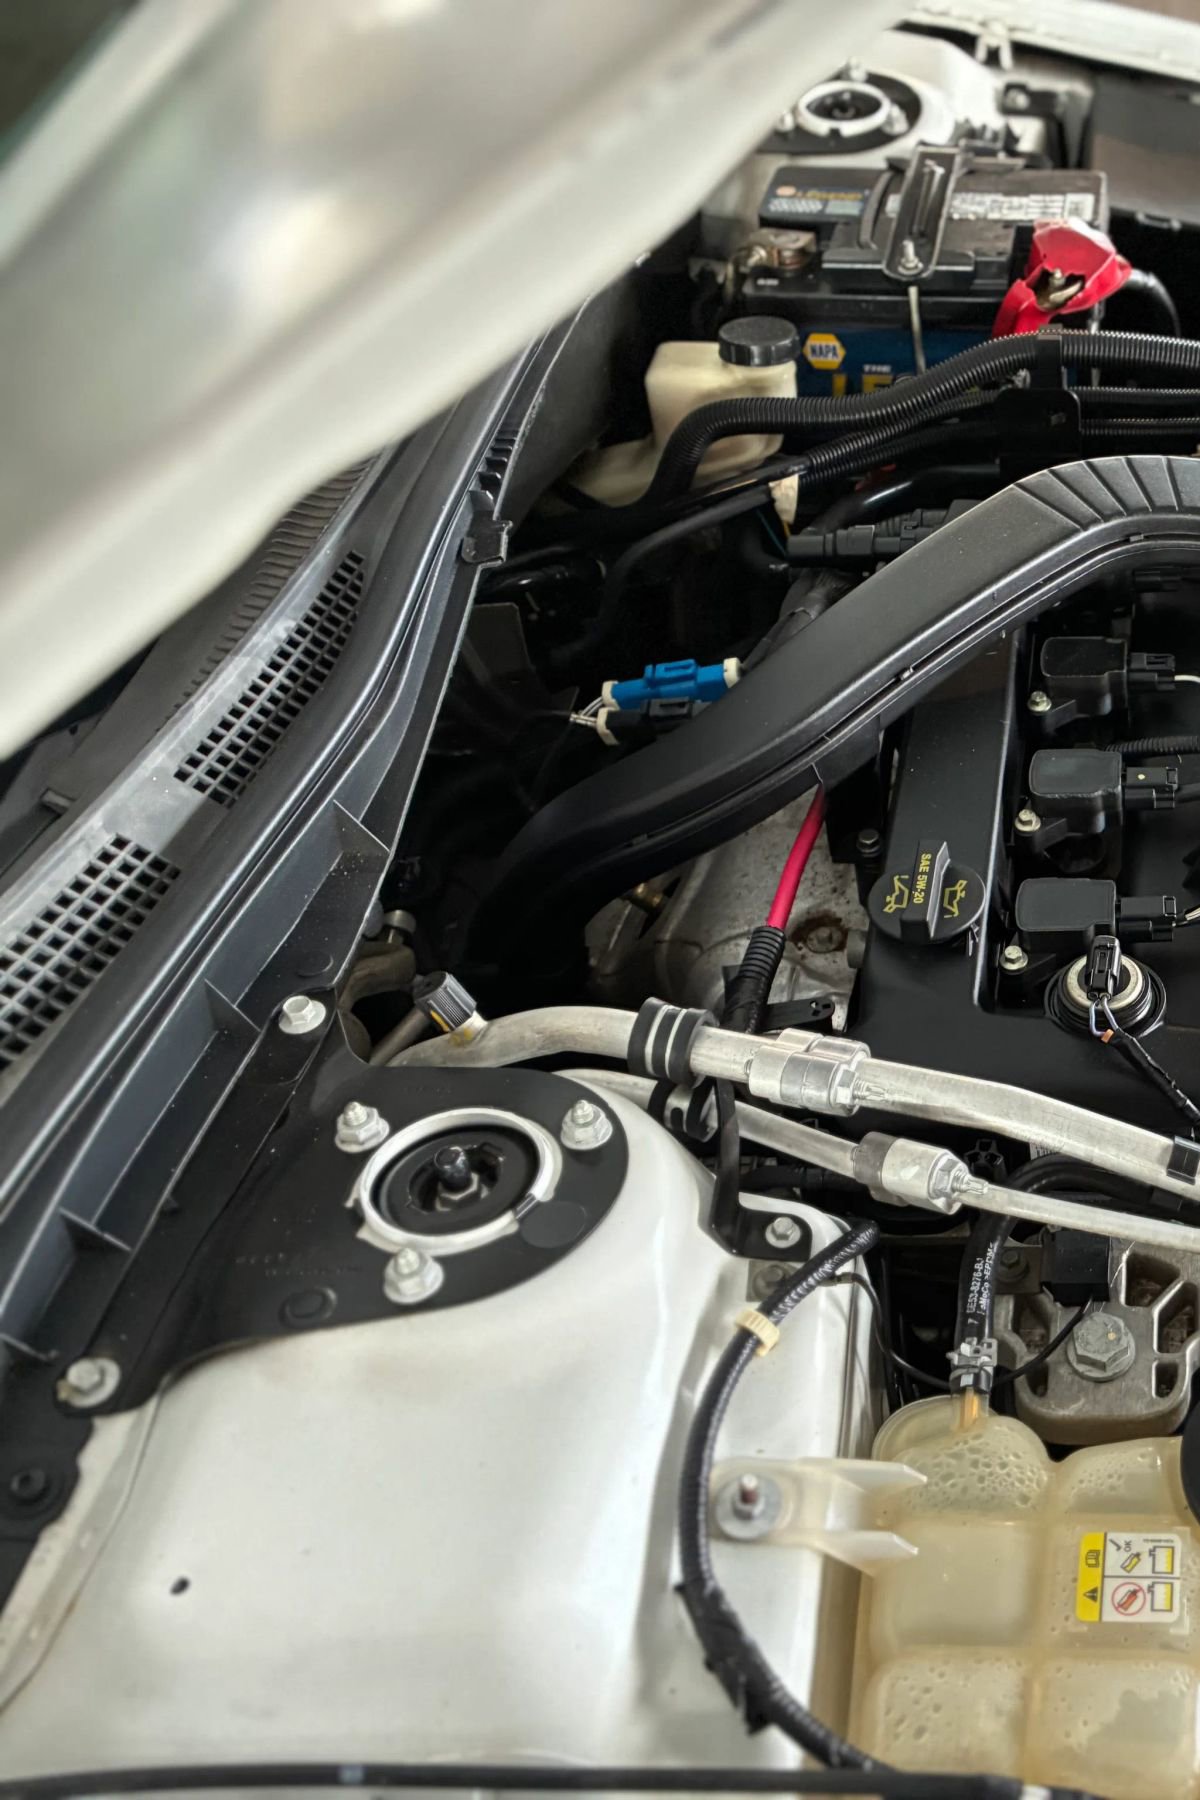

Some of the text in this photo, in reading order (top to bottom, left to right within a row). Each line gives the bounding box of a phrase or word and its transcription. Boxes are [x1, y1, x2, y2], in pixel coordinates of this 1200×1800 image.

[810, 344, 839, 359] NAPA
[864, 364, 891, 373] THE
[913, 853, 931, 903] SAE 5W-20
[1124, 1540, 1132, 1552] OK
